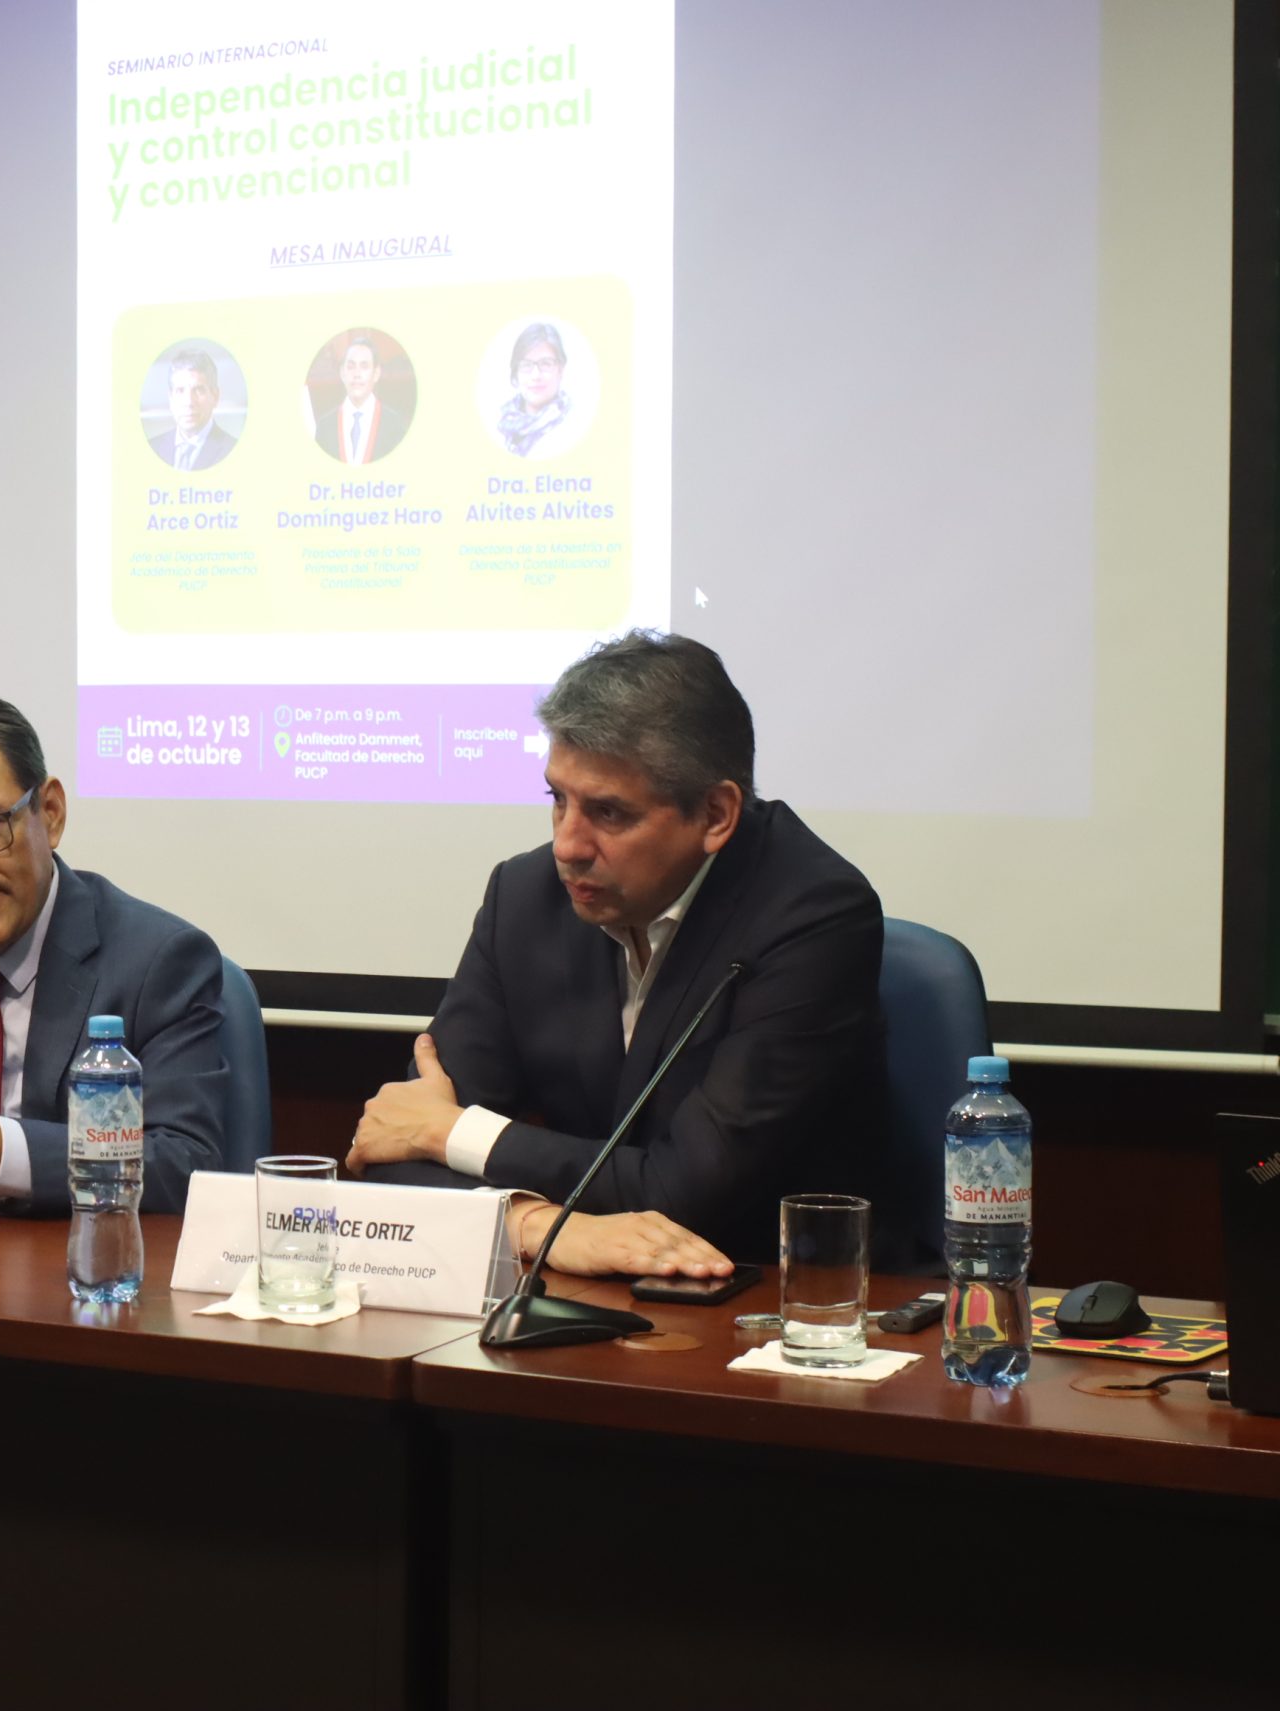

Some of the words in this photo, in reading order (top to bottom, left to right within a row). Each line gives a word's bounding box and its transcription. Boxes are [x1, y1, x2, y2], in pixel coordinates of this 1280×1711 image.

[108, 52, 194, 76] SEMINARIO
[199, 37, 329, 65] INTERNACIONAL
[109, 59, 408, 128] Independencia
[419, 43, 577, 103] judicial
[108, 140, 130, 179] y
[139, 118, 278, 166] control
[288, 88, 593, 151] constitucional
[108, 183, 130, 224] y
[139, 150, 412, 208] convencional
[270, 243, 326, 265] MESA
[331, 234, 453, 262] INAUGURAL
[308, 483, 335, 501] Dr.
[341, 480, 406, 500] Helder
[488, 476, 529, 495] Dra.
[535, 474, 593, 494] Elena
[148, 488, 174, 506] Dr.
[179, 487, 234, 504] Elmer
[146, 514, 190, 530] Arce
[194, 510, 239, 530] Ortiz
[277, 506, 389, 532] Domínguez
[394, 507, 443, 525] Haro
[466, 502, 536, 522] Alvites
[542, 500, 615, 521] Alvites
[295, 708, 312, 721] De
[315, 708, 322, 720] 7
[353, 710, 363, 721] a
[365, 708, 374, 721] 9
[126, 714, 183, 740] Lima,
[187, 714, 208, 737] 12
[212, 720, 225, 743] y
[229, 715, 250, 737] 13
[295, 732, 357, 746] Anfiteatro
[126, 743, 155, 765] de
[157, 743, 242, 765] octubre
[294, 750, 350, 763] Facultad
[352, 750, 369, 763] de
[371, 750, 425, 764] Derecho
[294, 766, 328, 779] PUCP
[86, 1128, 118, 1143] San
[953, 1185, 986, 1203] San
[980, 1211, 1026, 1220] MANANTIA
[266, 1211, 312, 1234] ELMER
[365, 1221, 415, 1242] ORTIZ
[348, 1261, 361, 1273] de
[363, 1262, 405, 1277] Derecho
[407, 1266, 437, 1279] PUCP
